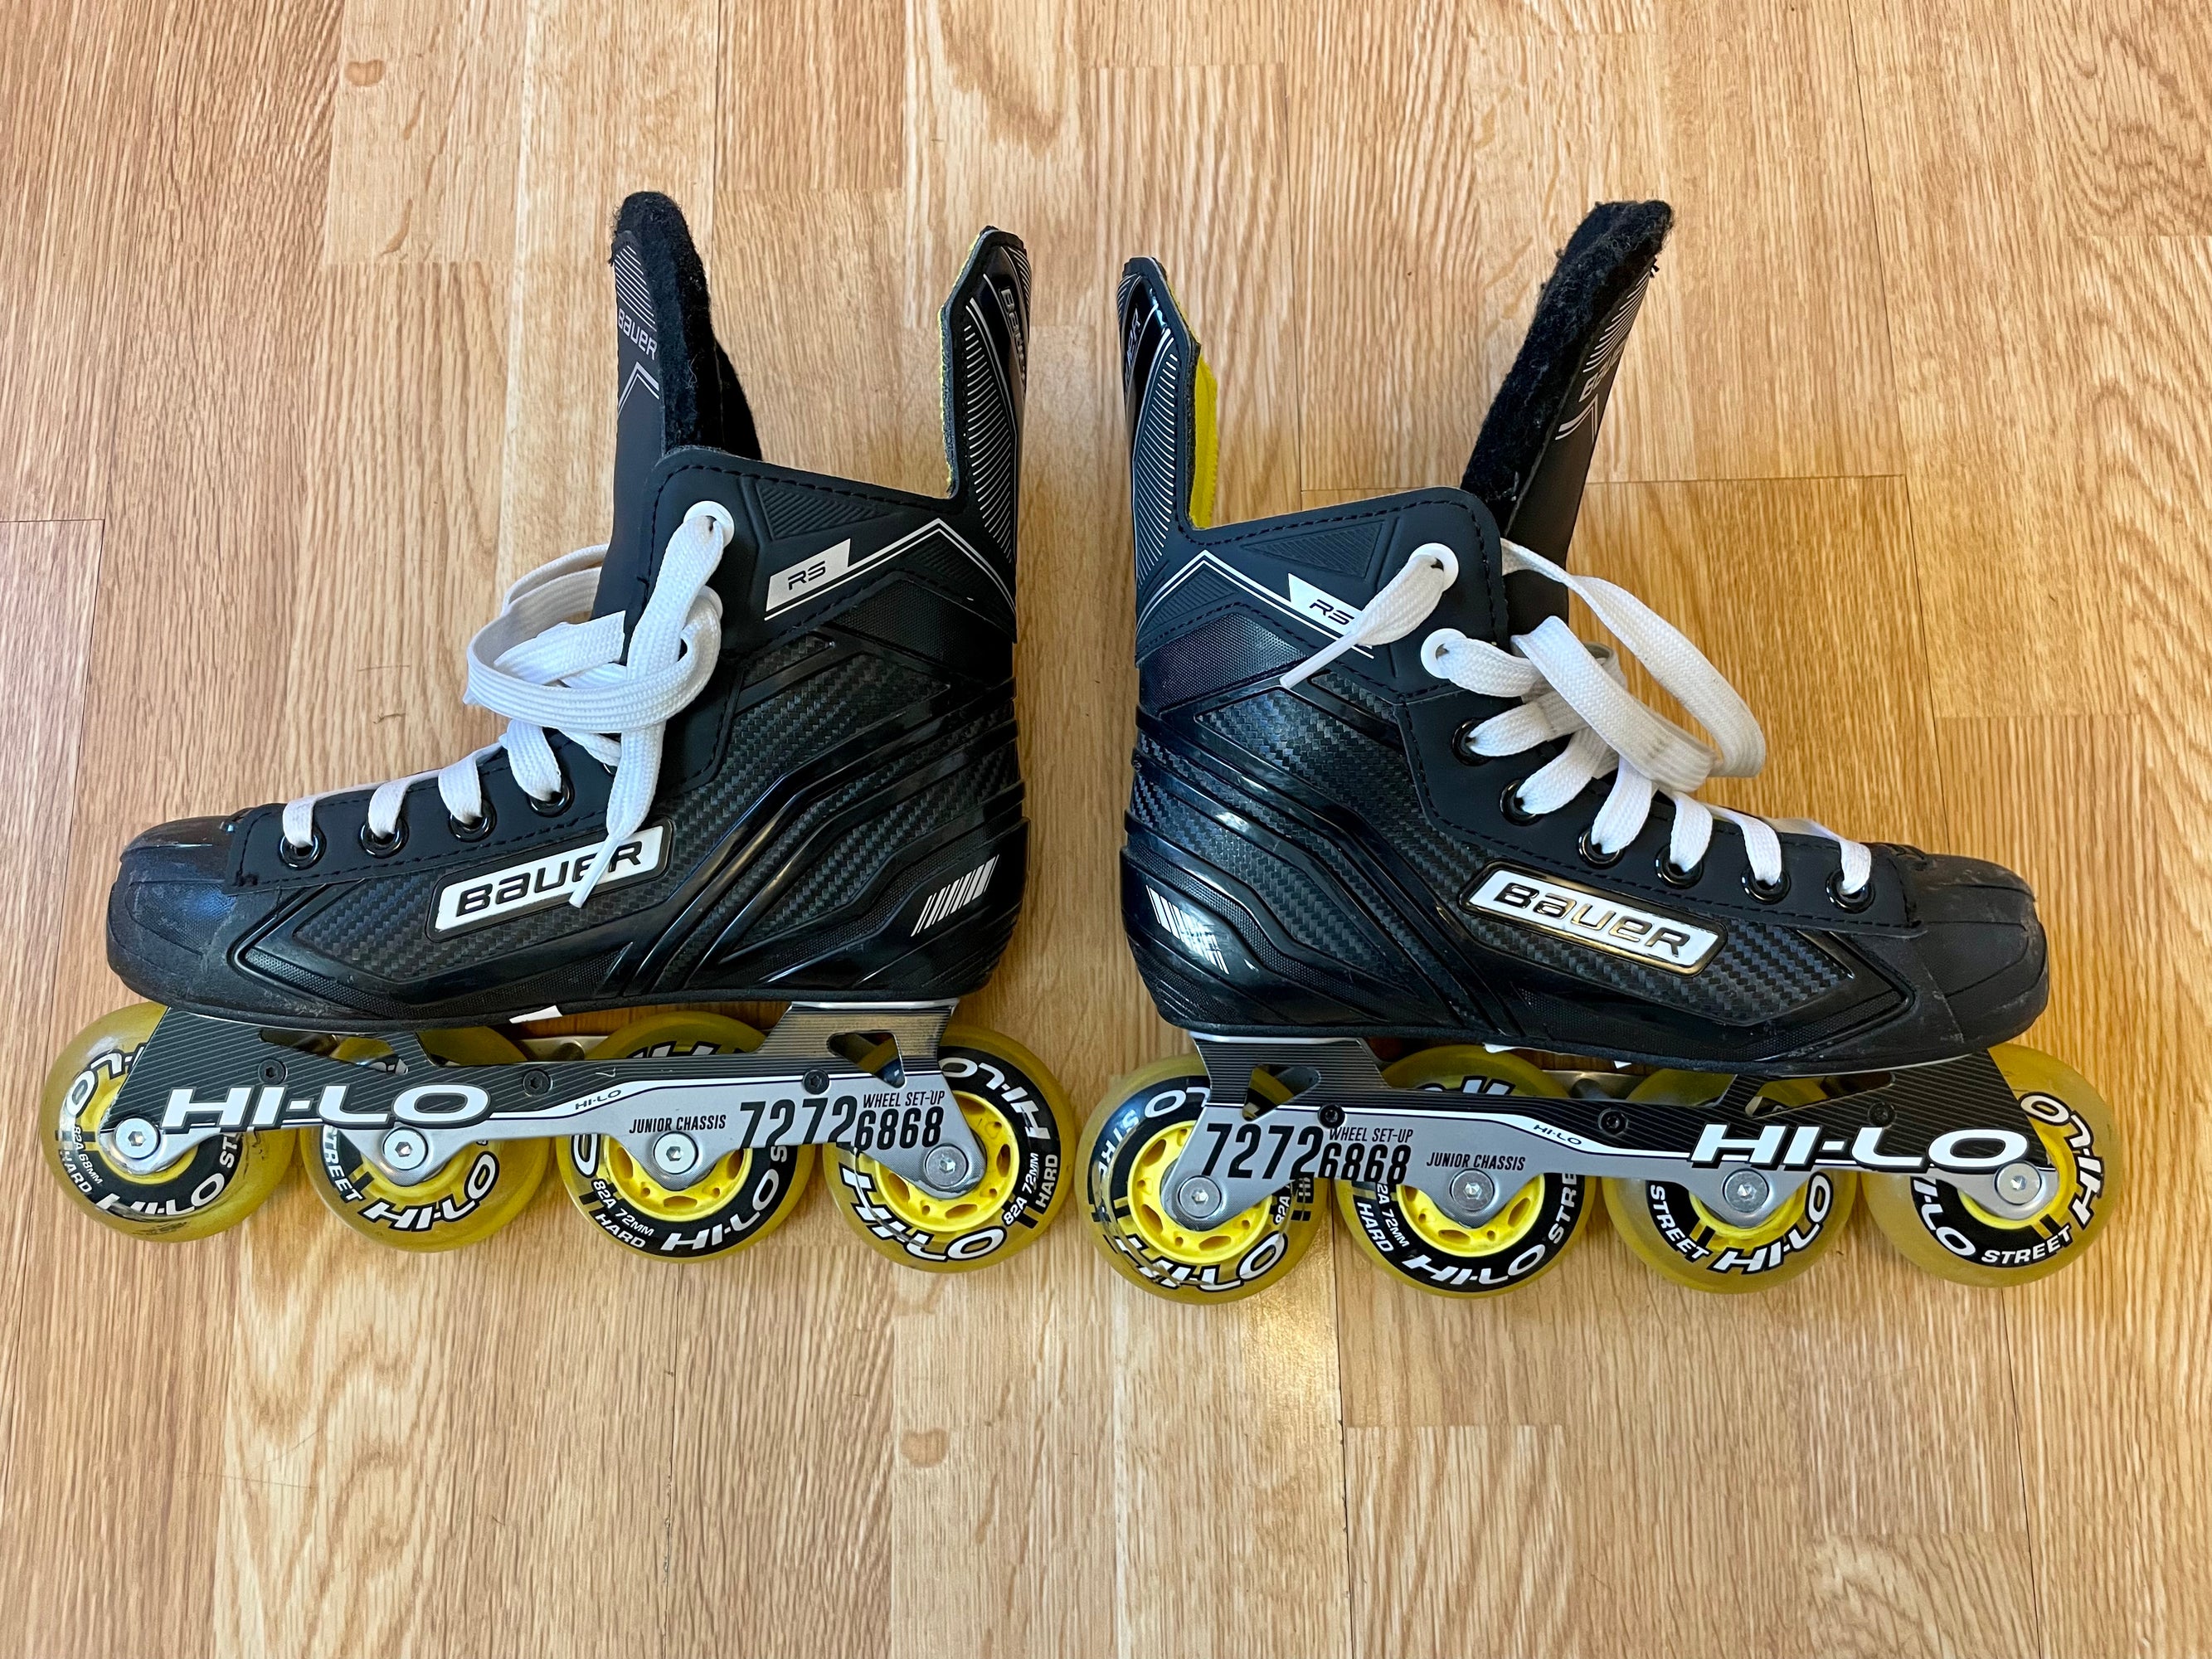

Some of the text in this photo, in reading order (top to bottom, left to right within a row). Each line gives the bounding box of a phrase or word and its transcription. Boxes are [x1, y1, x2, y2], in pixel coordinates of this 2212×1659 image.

[618, 307, 658, 361] BAUER
[787, 560, 826, 591] RS
[1309, 599, 1355, 626] RS
[1493, 881, 1692, 959] BAUER
[162, 1084, 490, 1127] HI-LO
[574, 1089, 622, 1110] HI-LO
[629, 1114, 727, 1134] JUNIOR CHASSIS
[739, 1095, 945, 1151] 7272 6868
[863, 1090, 946, 1109] WHEEL SET-UP
[938, 1057, 1052, 1141] HI-LO
[73, 1124, 104, 1185] 82A 68MM
[1200, 1123, 1412, 1185] 7272 6868
[1329, 1126, 1414, 1143] WHEEL SET-UP
[1533, 1124, 1582, 1146] HI-LO
[1689, 1122, 2029, 1169] HI-LO
[2020, 1094, 2103, 1225] HI-LO
[62, 1150, 92, 1194] HARD
[1036, 1153, 1058, 1209] HARD
[1427, 1151, 1526, 1171] JUNIOR CHASSIS
[361, 1153, 498, 1230] HI-LO
[592, 1179, 655, 1237] 82A 72MM
[659, 1168, 780, 1251] HI-LO
[841, 1166, 1005, 1262] HI-LO
[1003, 1152, 1039, 1225] 82A 72MM
[595, 1213, 646, 1248] HARD
[1357, 1202, 1394, 1253] HARD
[1381, 1209, 1410, 1248] 72MM
[1650, 1184, 1710, 1260] STREET
[1710, 1174, 1832, 1272] HI-LO
[1913, 1177, 1976, 1257] I-LO
[1401, 1243, 1546, 1286] HI-LO
[1981, 1224, 2073, 1263] STREET
